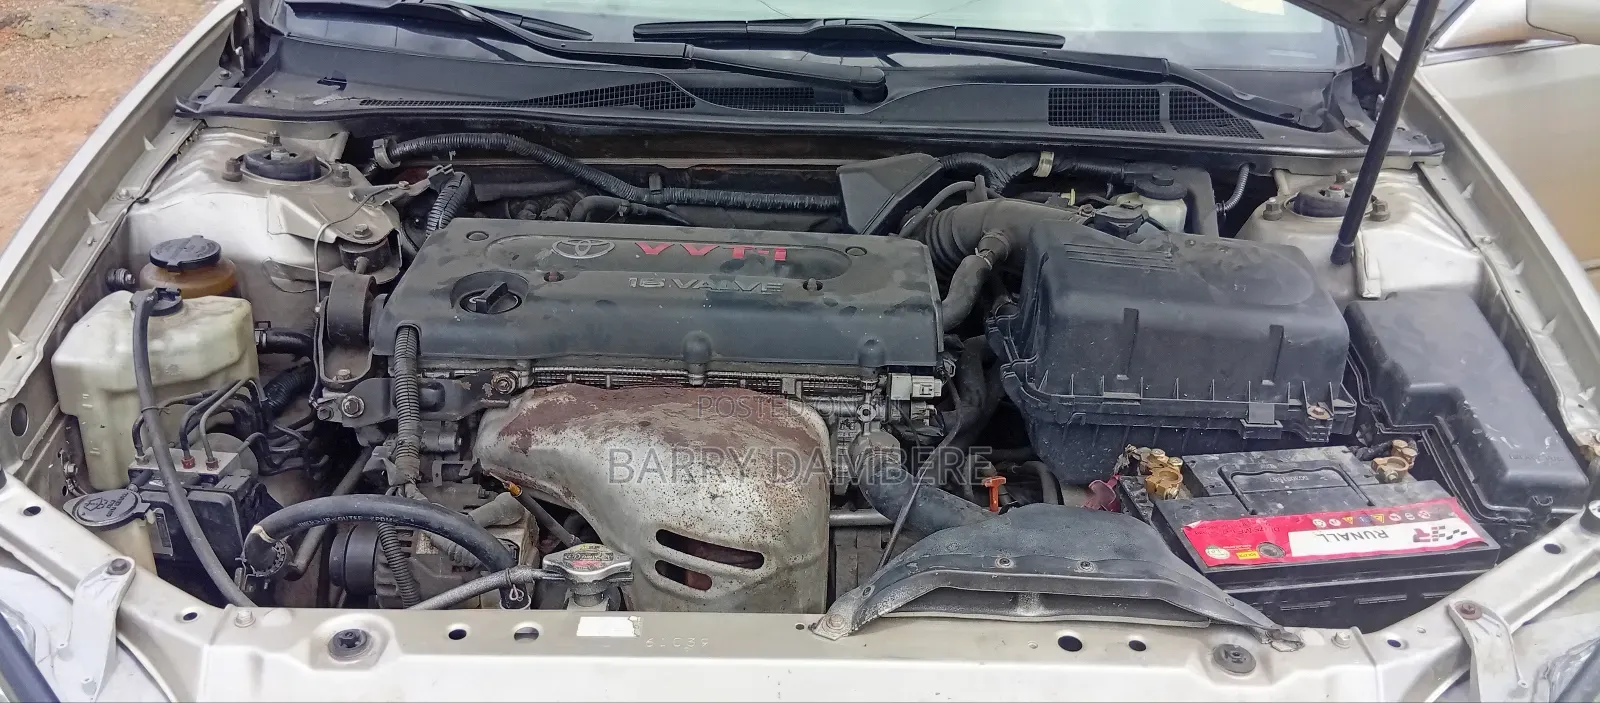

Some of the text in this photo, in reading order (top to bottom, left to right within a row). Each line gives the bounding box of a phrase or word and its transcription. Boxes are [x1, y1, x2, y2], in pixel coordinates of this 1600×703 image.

[629, 277, 785, 295] 16 VALVE
[1315, 529, 1389, 543] RUNALL
